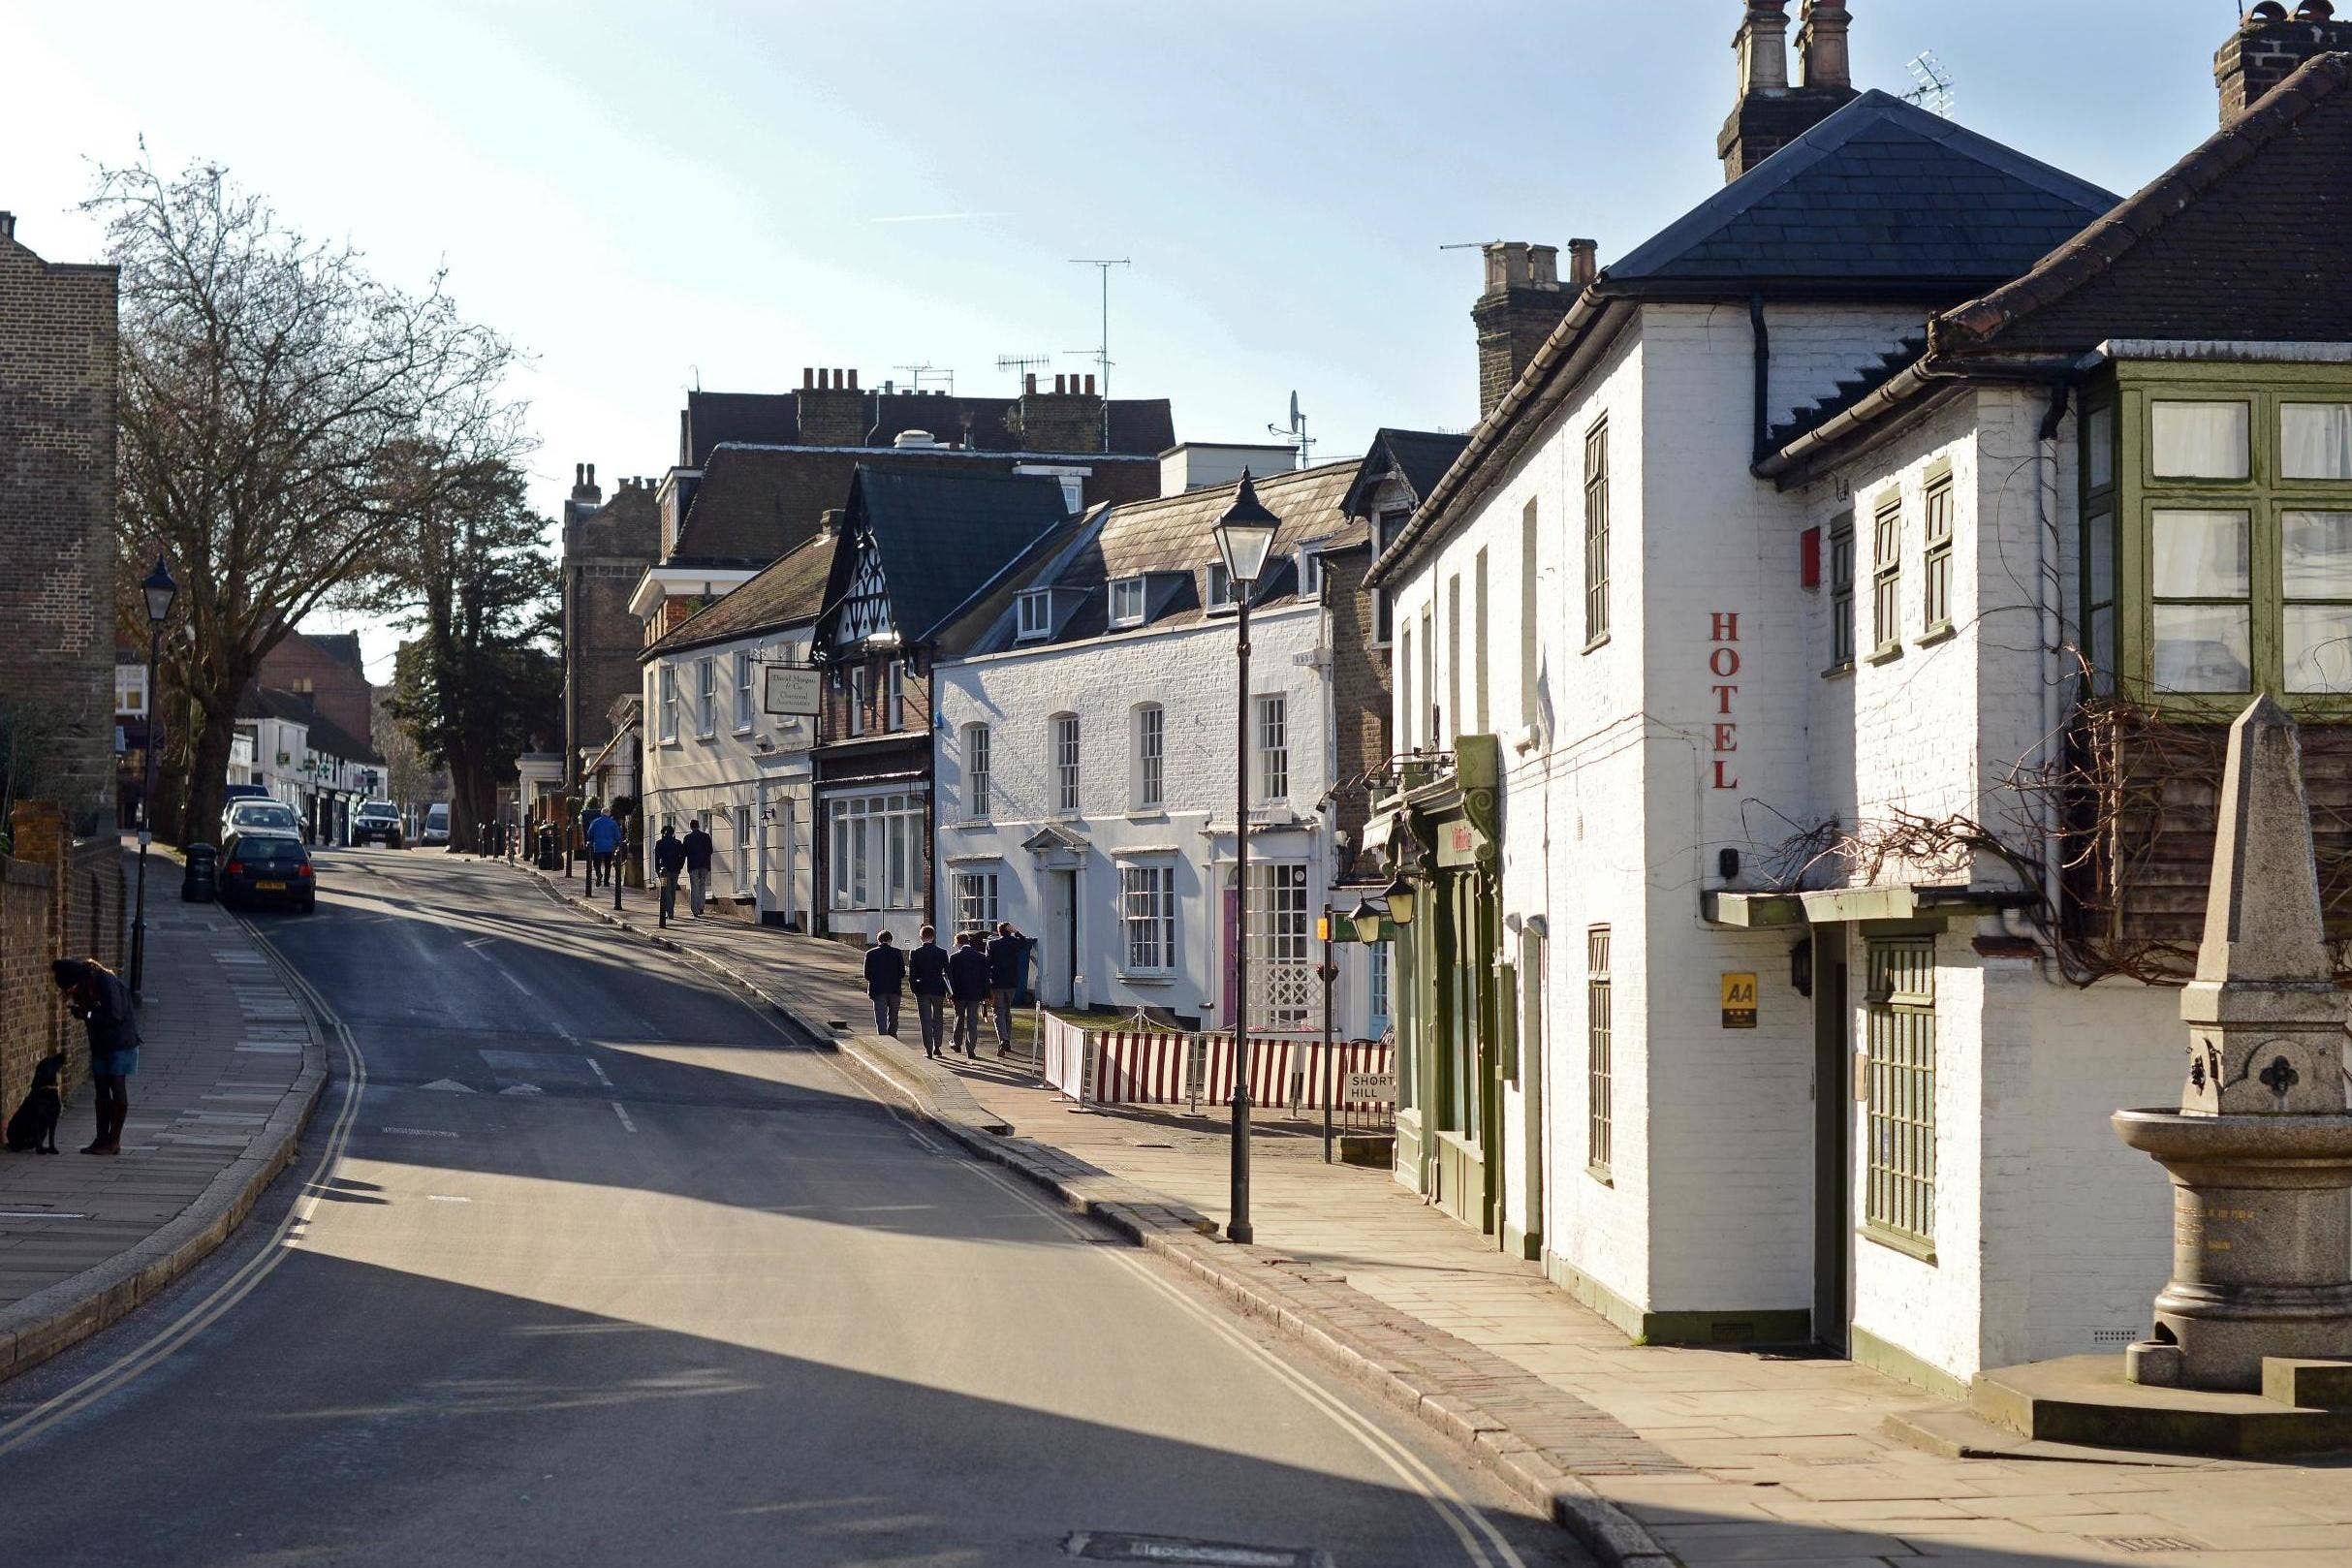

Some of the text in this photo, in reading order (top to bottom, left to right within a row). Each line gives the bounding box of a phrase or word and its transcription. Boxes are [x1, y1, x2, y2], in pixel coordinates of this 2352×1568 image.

[1709, 612, 1740, 789] HOTEL
[1727, 983, 1753, 1003] AA
[1352, 1077, 1395, 1085] SHORT
[1351, 1088, 1377, 1097] HILL
